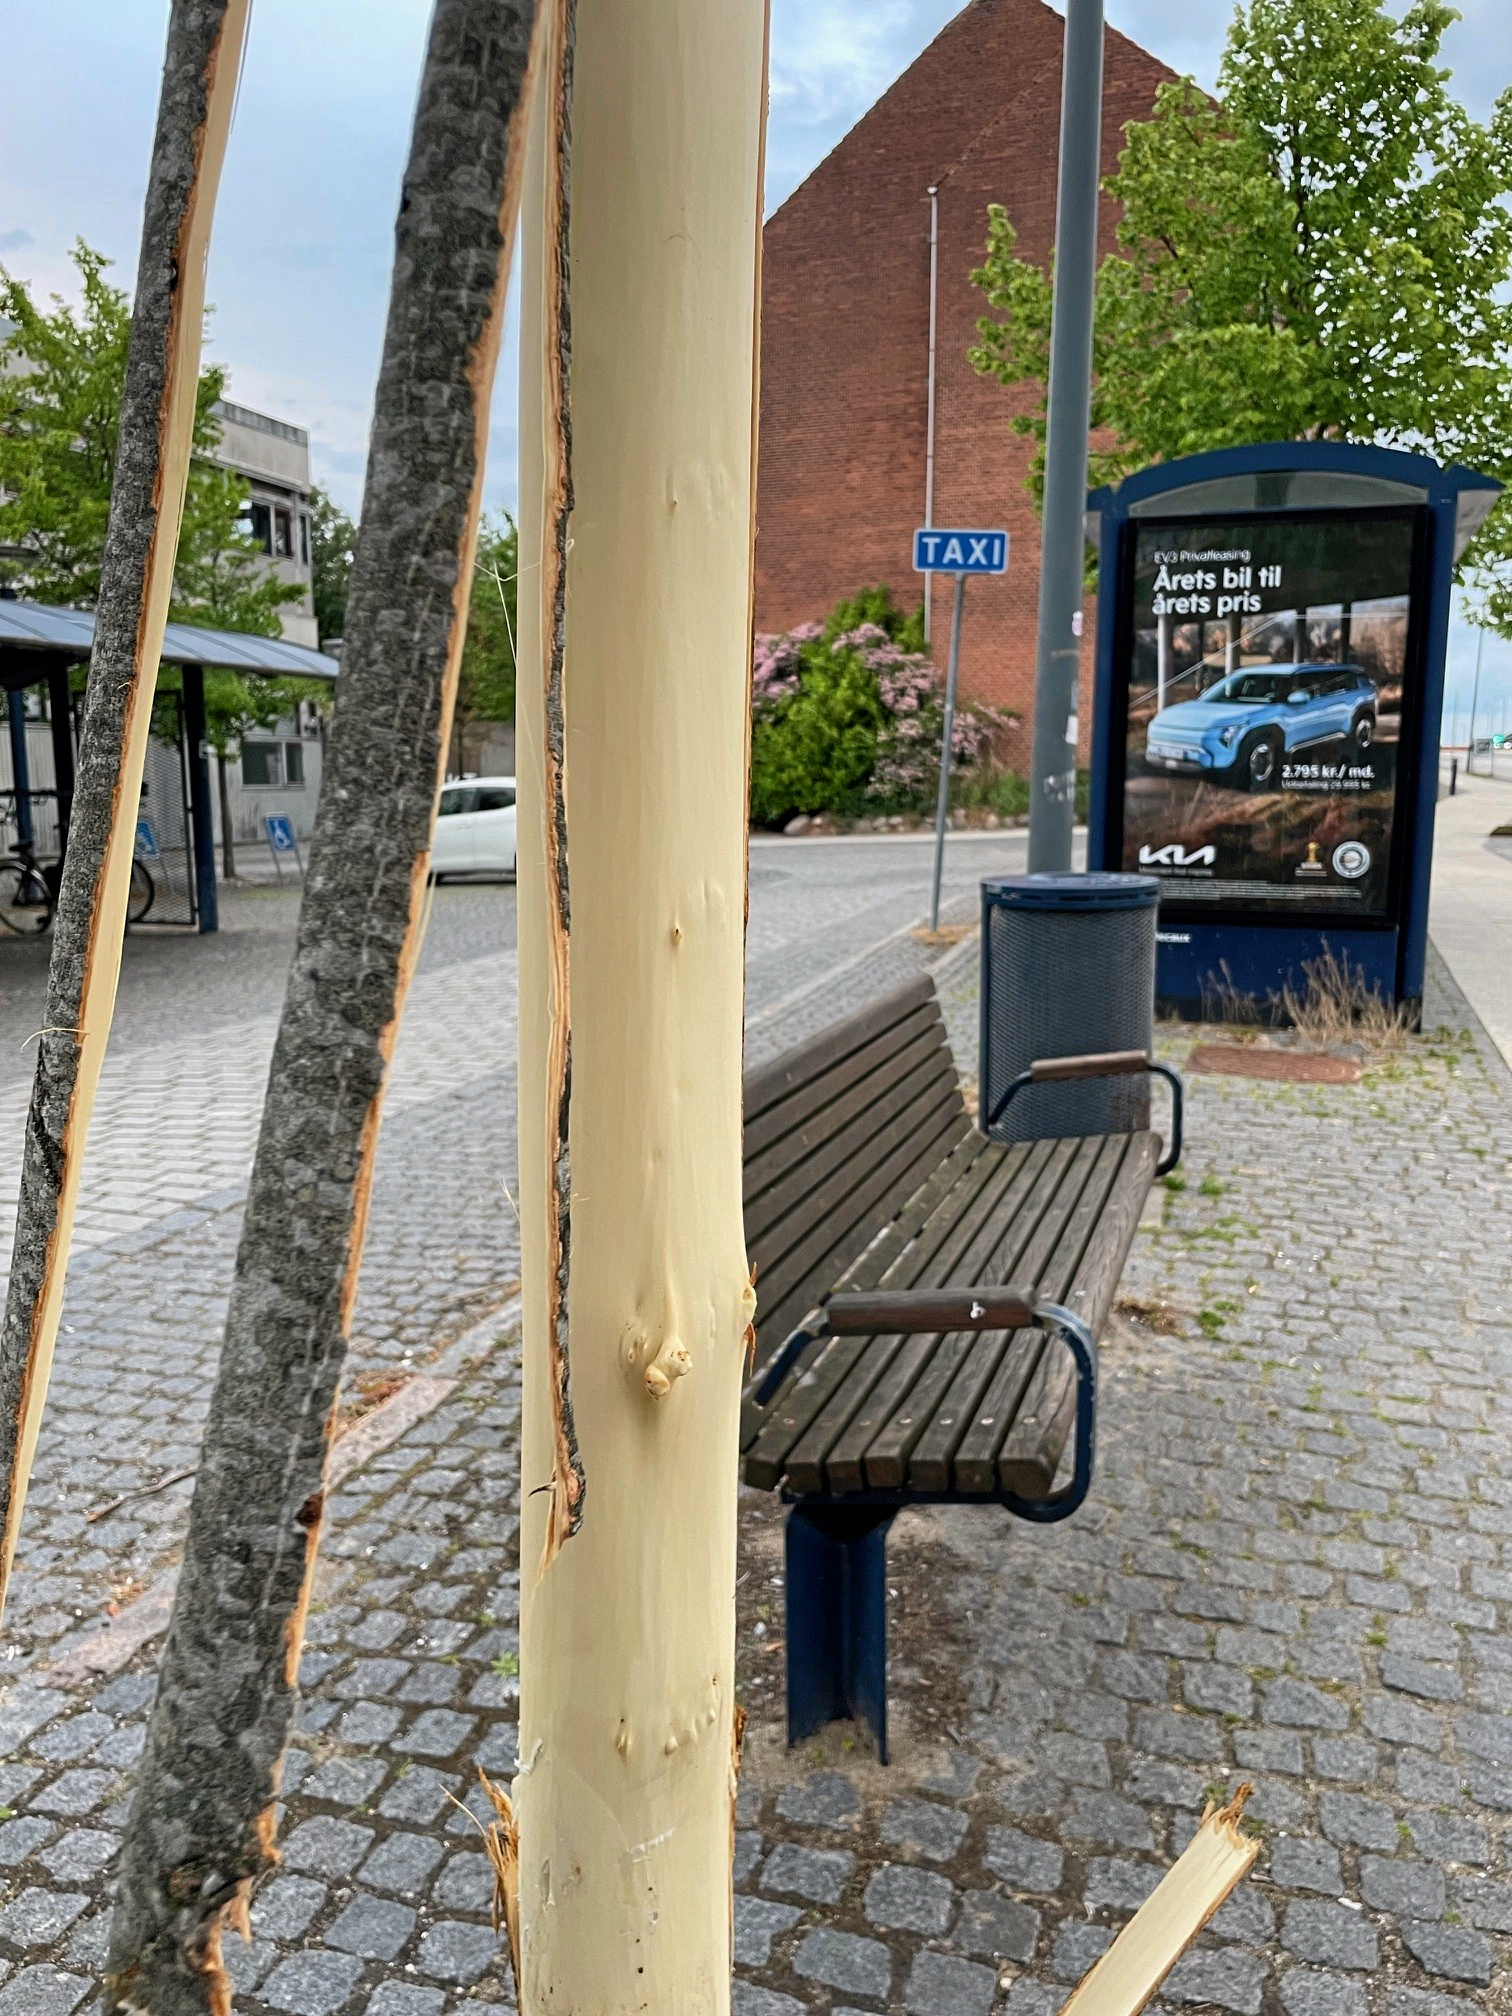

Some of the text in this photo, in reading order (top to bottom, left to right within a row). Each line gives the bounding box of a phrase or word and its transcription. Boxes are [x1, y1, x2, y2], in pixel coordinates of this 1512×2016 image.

[921, 537, 1001, 566] TAXI
[1180, 549, 1251, 563] Privatleasing
[1152, 564, 1282, 592] Årets bil til
[1152, 590, 1262, 618] årets pris
[1282, 764, 1320, 779] 2.795
